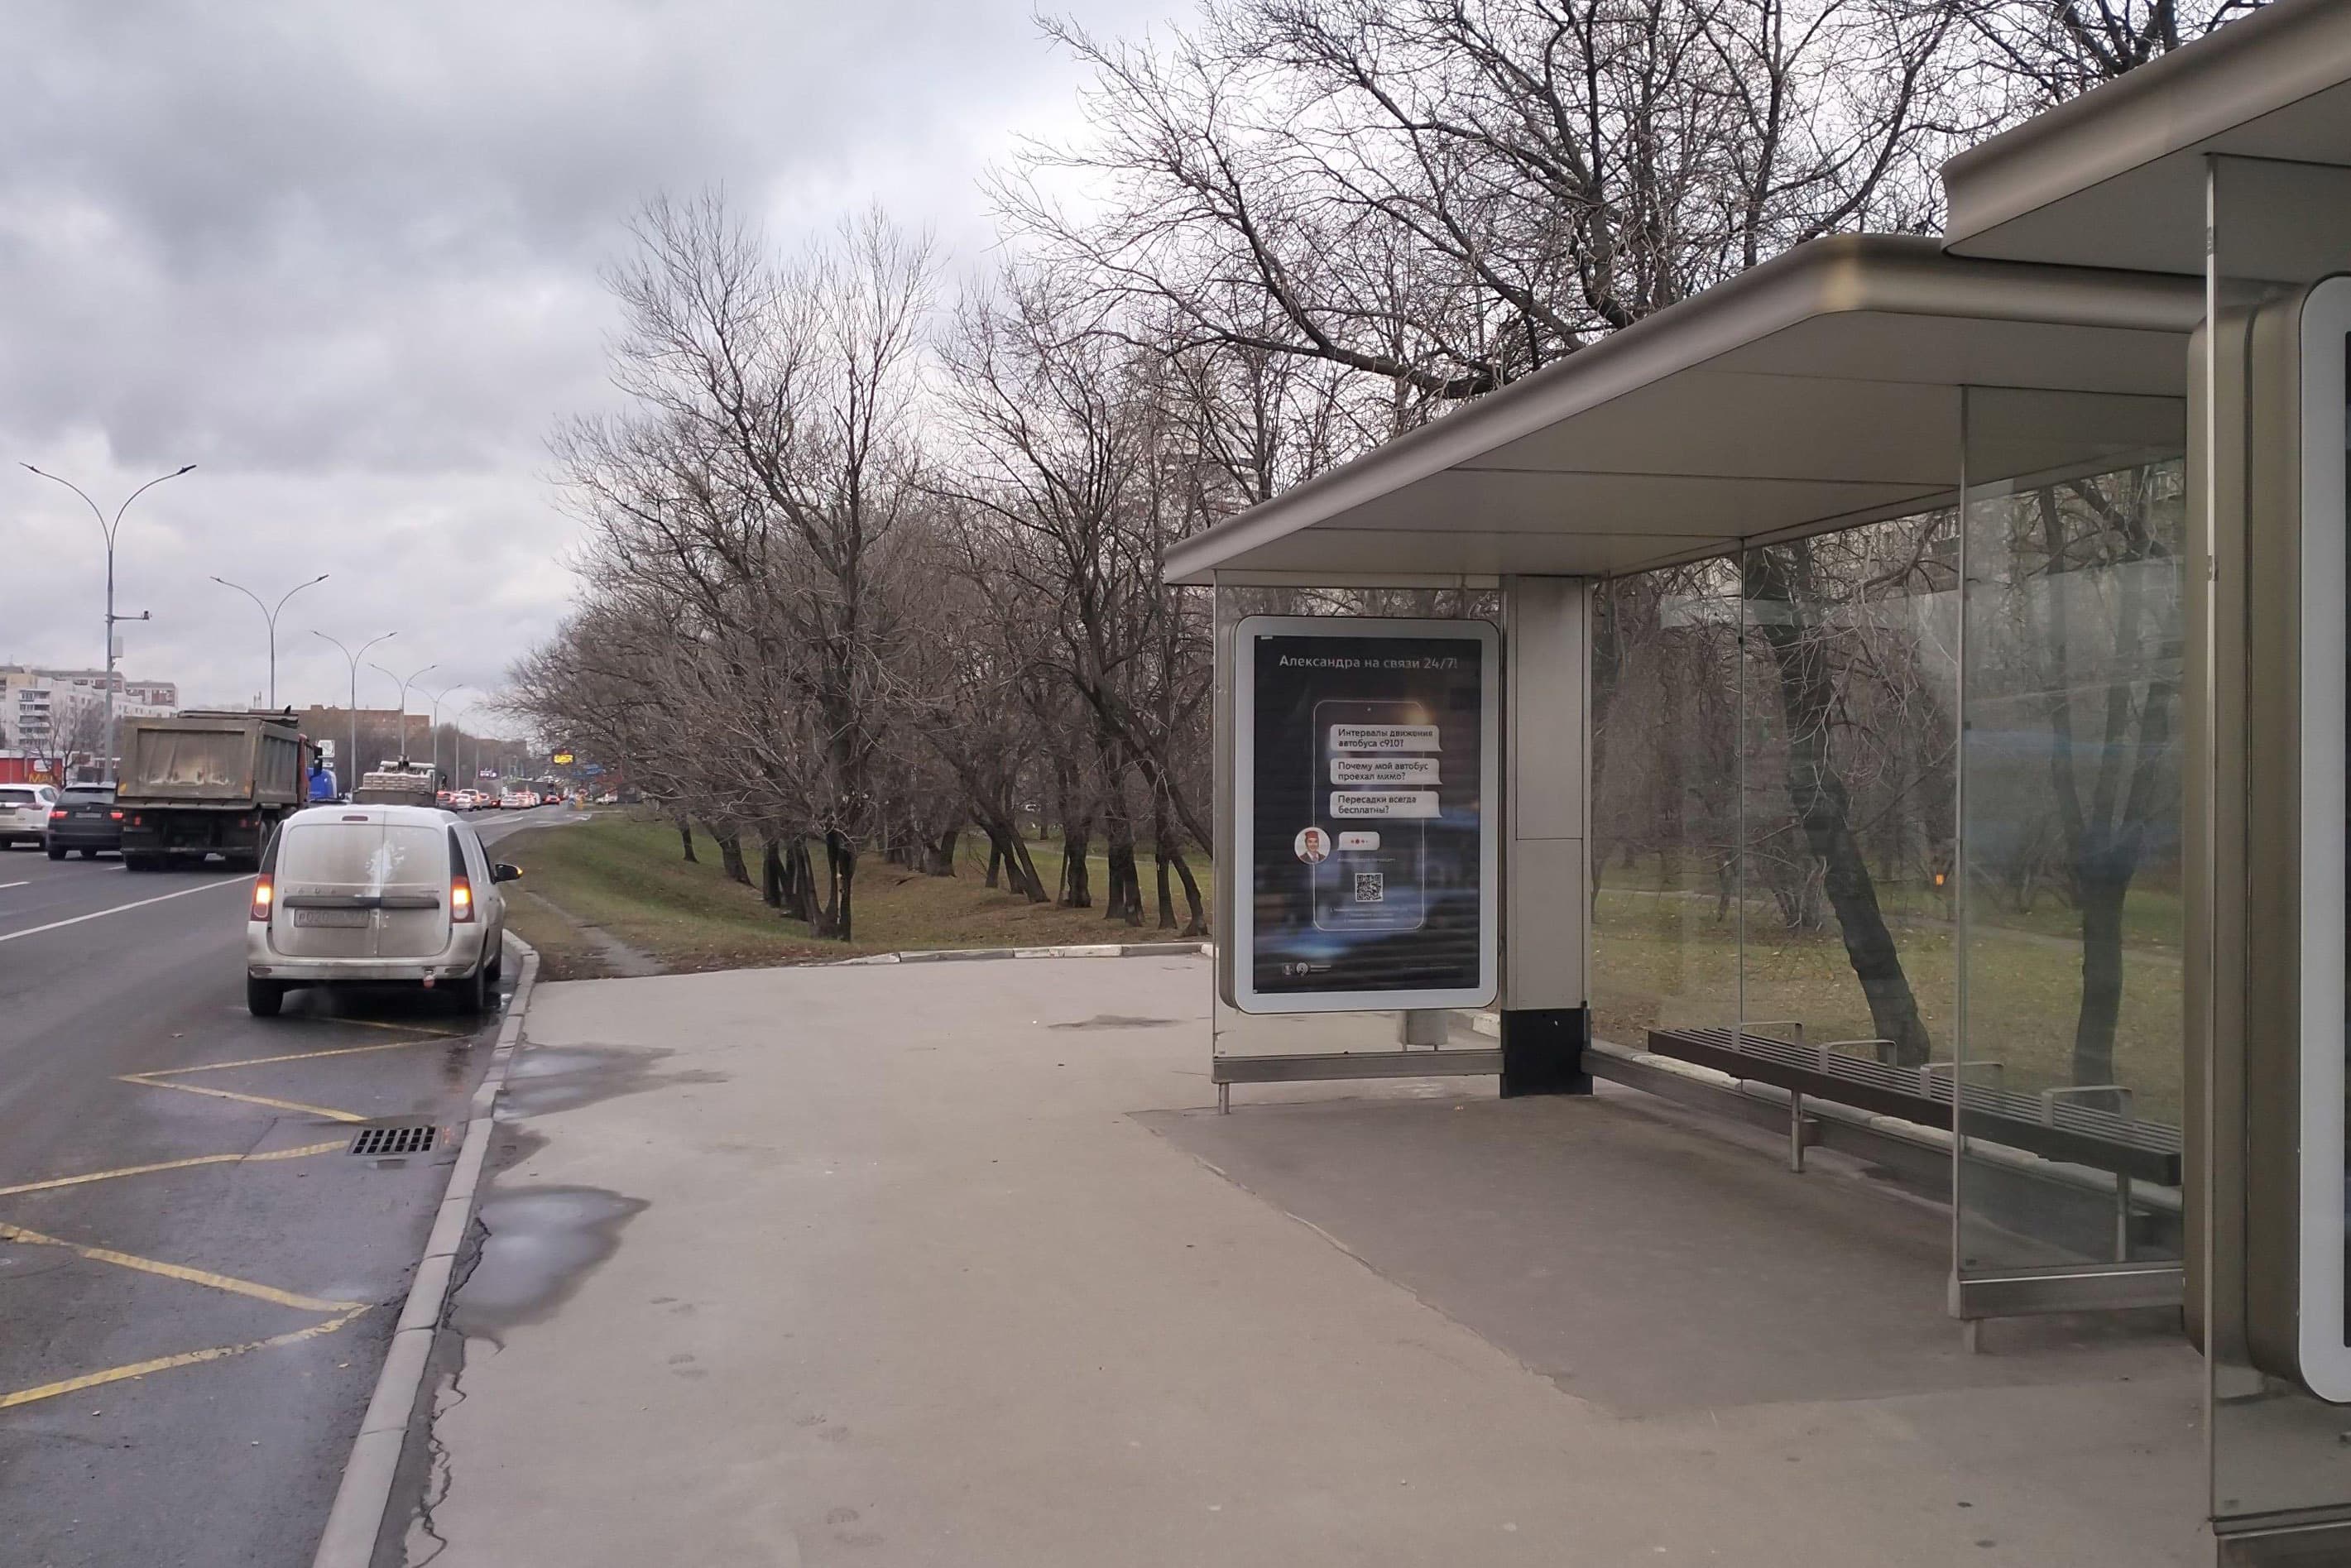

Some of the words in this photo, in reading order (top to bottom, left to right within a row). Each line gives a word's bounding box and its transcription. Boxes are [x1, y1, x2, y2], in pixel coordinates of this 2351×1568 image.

[1279, 655, 1360, 669] Александра
[1365, 659, 1379, 669] на
[1384, 659, 1420, 669] связи
[1423, 657, 1457, 669] 24/7!
[1338, 728, 1388, 737] Интервалы
[1338, 739, 1378, 749] автобуса
[1338, 761, 1372, 772] Почему
[1375, 762, 1393, 770] мой
[1394, 761, 1429, 772] автобус
[1338, 773, 1375, 782] проехал
[1376, 771, 1406, 780] мимо?
[1338, 794, 1387, 805] Пересадки
[1389, 795, 1417, 804] всегда
[1338, 804, 1389, 814] бесплатны?
